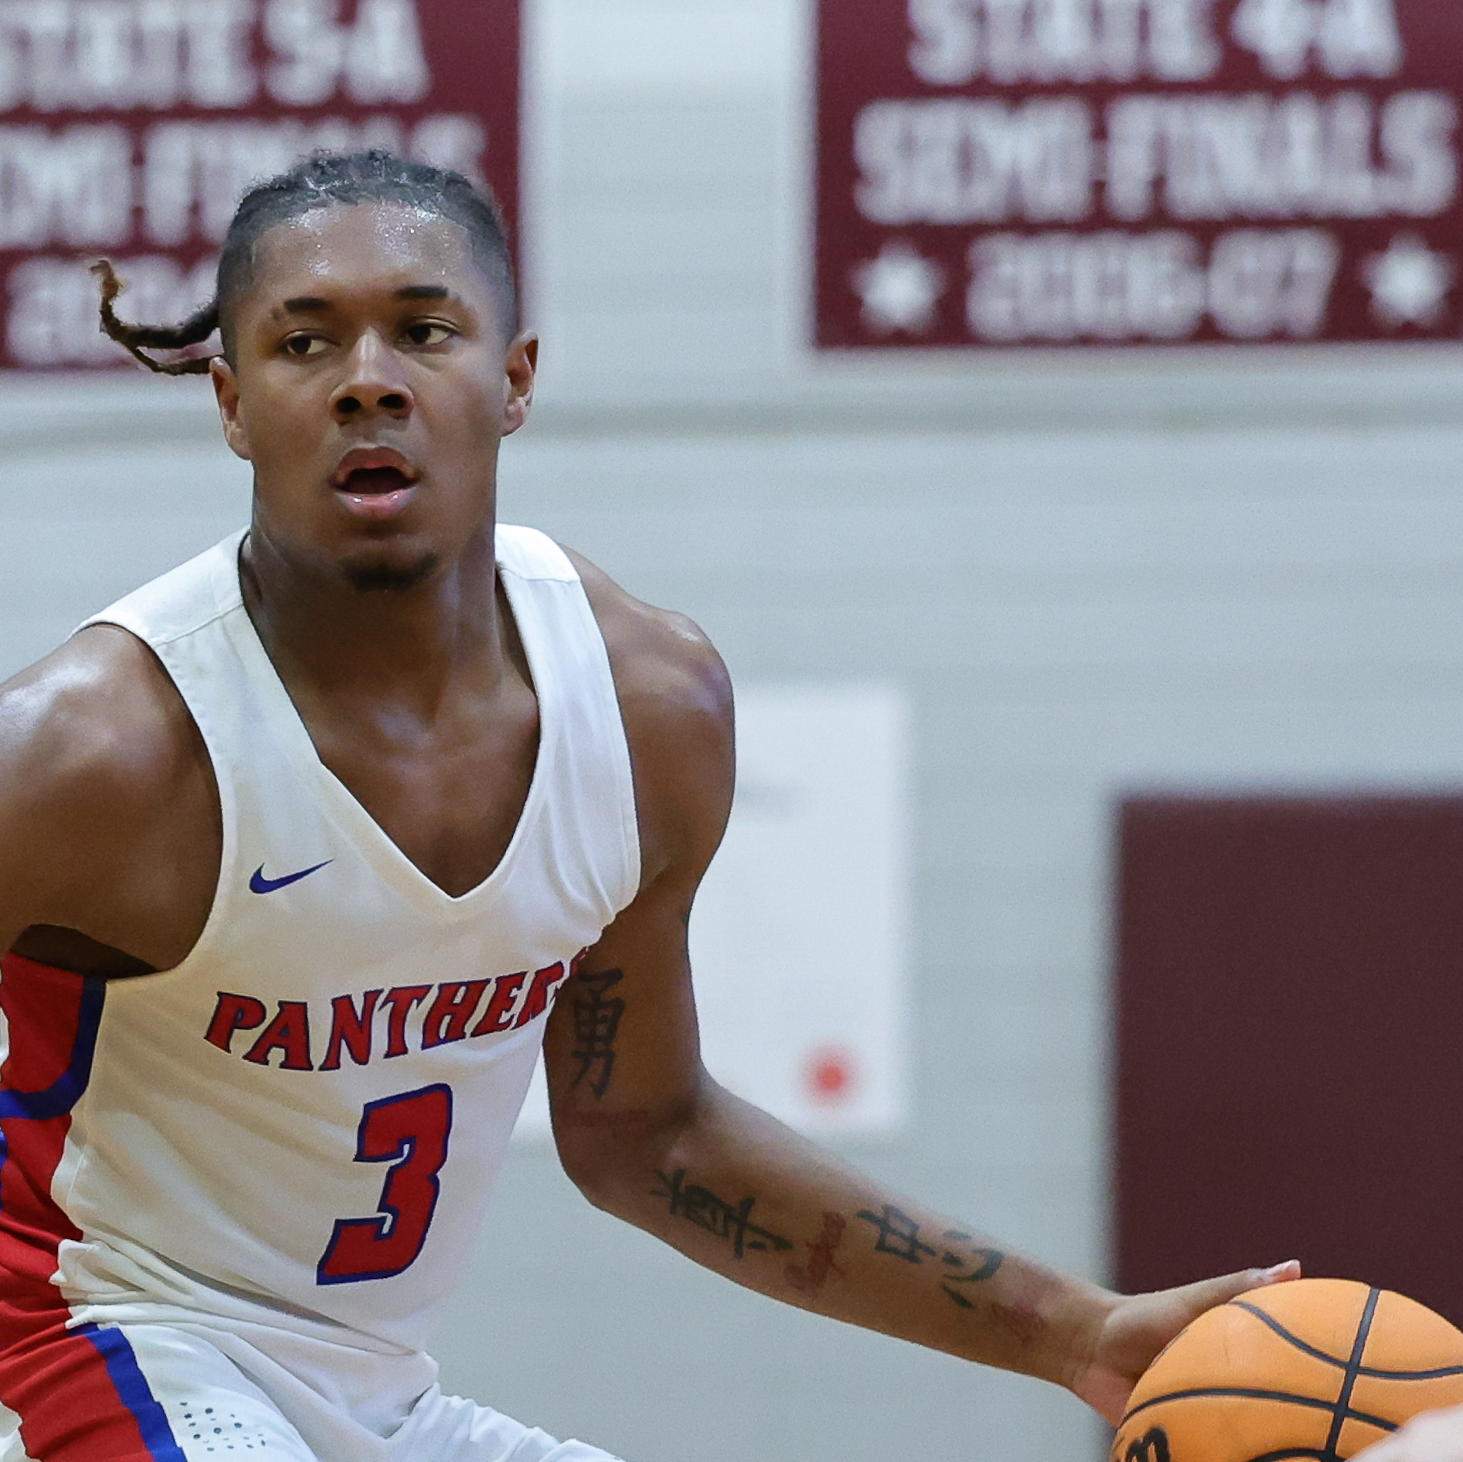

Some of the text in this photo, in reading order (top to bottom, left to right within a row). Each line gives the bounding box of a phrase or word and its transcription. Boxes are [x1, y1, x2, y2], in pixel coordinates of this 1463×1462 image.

[908, 0, 1221, 84] STATE
[853, 90, 1459, 225] SEMI-FINALS
[203, 946, 587, 1072] PANTHER
[316, 1083, 453, 1286] 3
